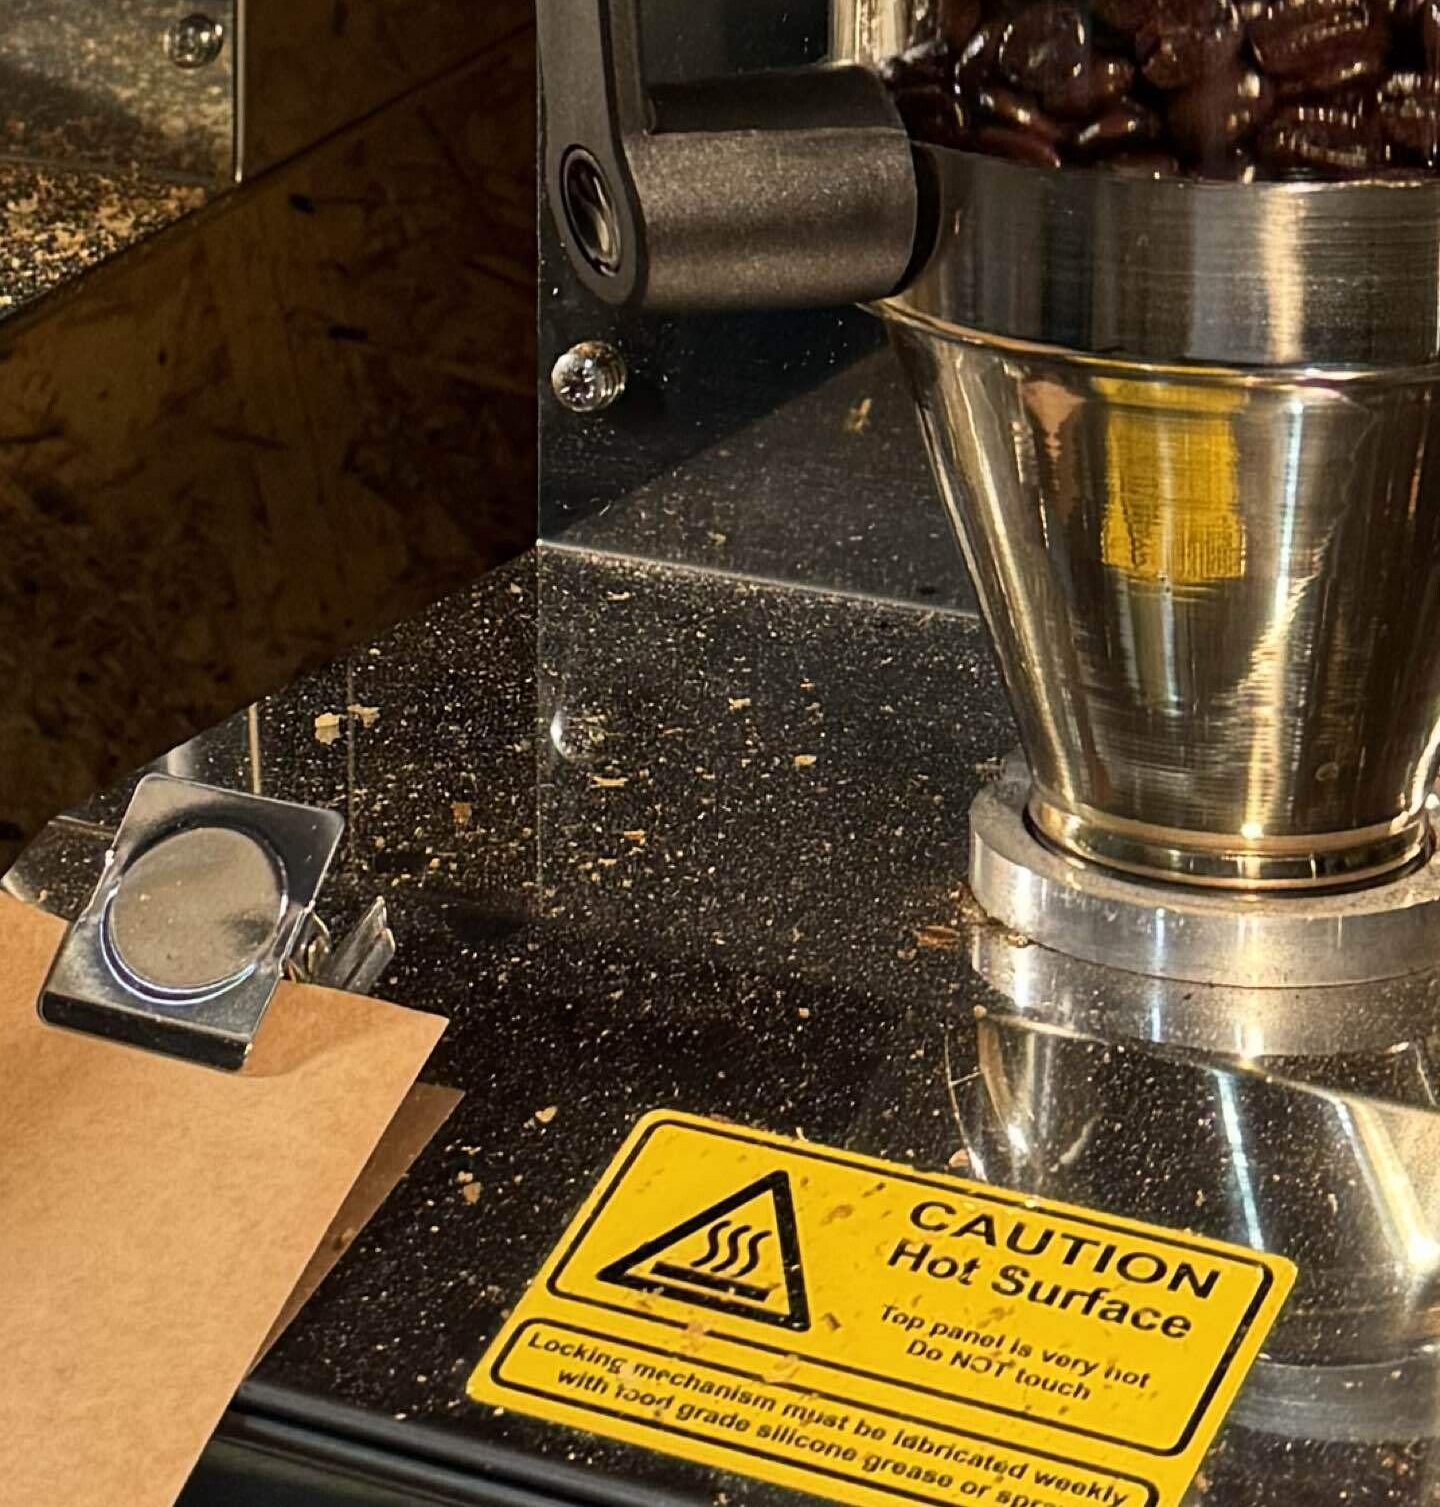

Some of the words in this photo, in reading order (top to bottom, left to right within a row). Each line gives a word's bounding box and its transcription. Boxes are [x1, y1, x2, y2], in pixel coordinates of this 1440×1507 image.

[886, 1237, 982, 1287] Hot
[991, 1263, 1193, 1339] Surface
[909, 1200, 1221, 1300] CAUTION
[879, 1303, 925, 1331] Top
[928, 1320, 1006, 1351] panel
[1010, 1336, 1032, 1359] is
[1041, 1349, 1100, 1378] very
[906, 1338, 943, 1363] Do
[1015, 1368, 1092, 1401] touch
[527, 1331, 624, 1376] Locking
[632, 1360, 777, 1414] mechanism
[781, 1403, 850, 1434] must
[853, 1415, 888, 1442] be
[1033, 1469, 1131, 1507] weekly
[557, 1368, 609, 1394] with
[677, 1400, 751, 1434] grade
[755, 1420, 858, 1463] silicone
[861, 1450, 954, 1489] grease
[959, 1478, 993, 1500] or
